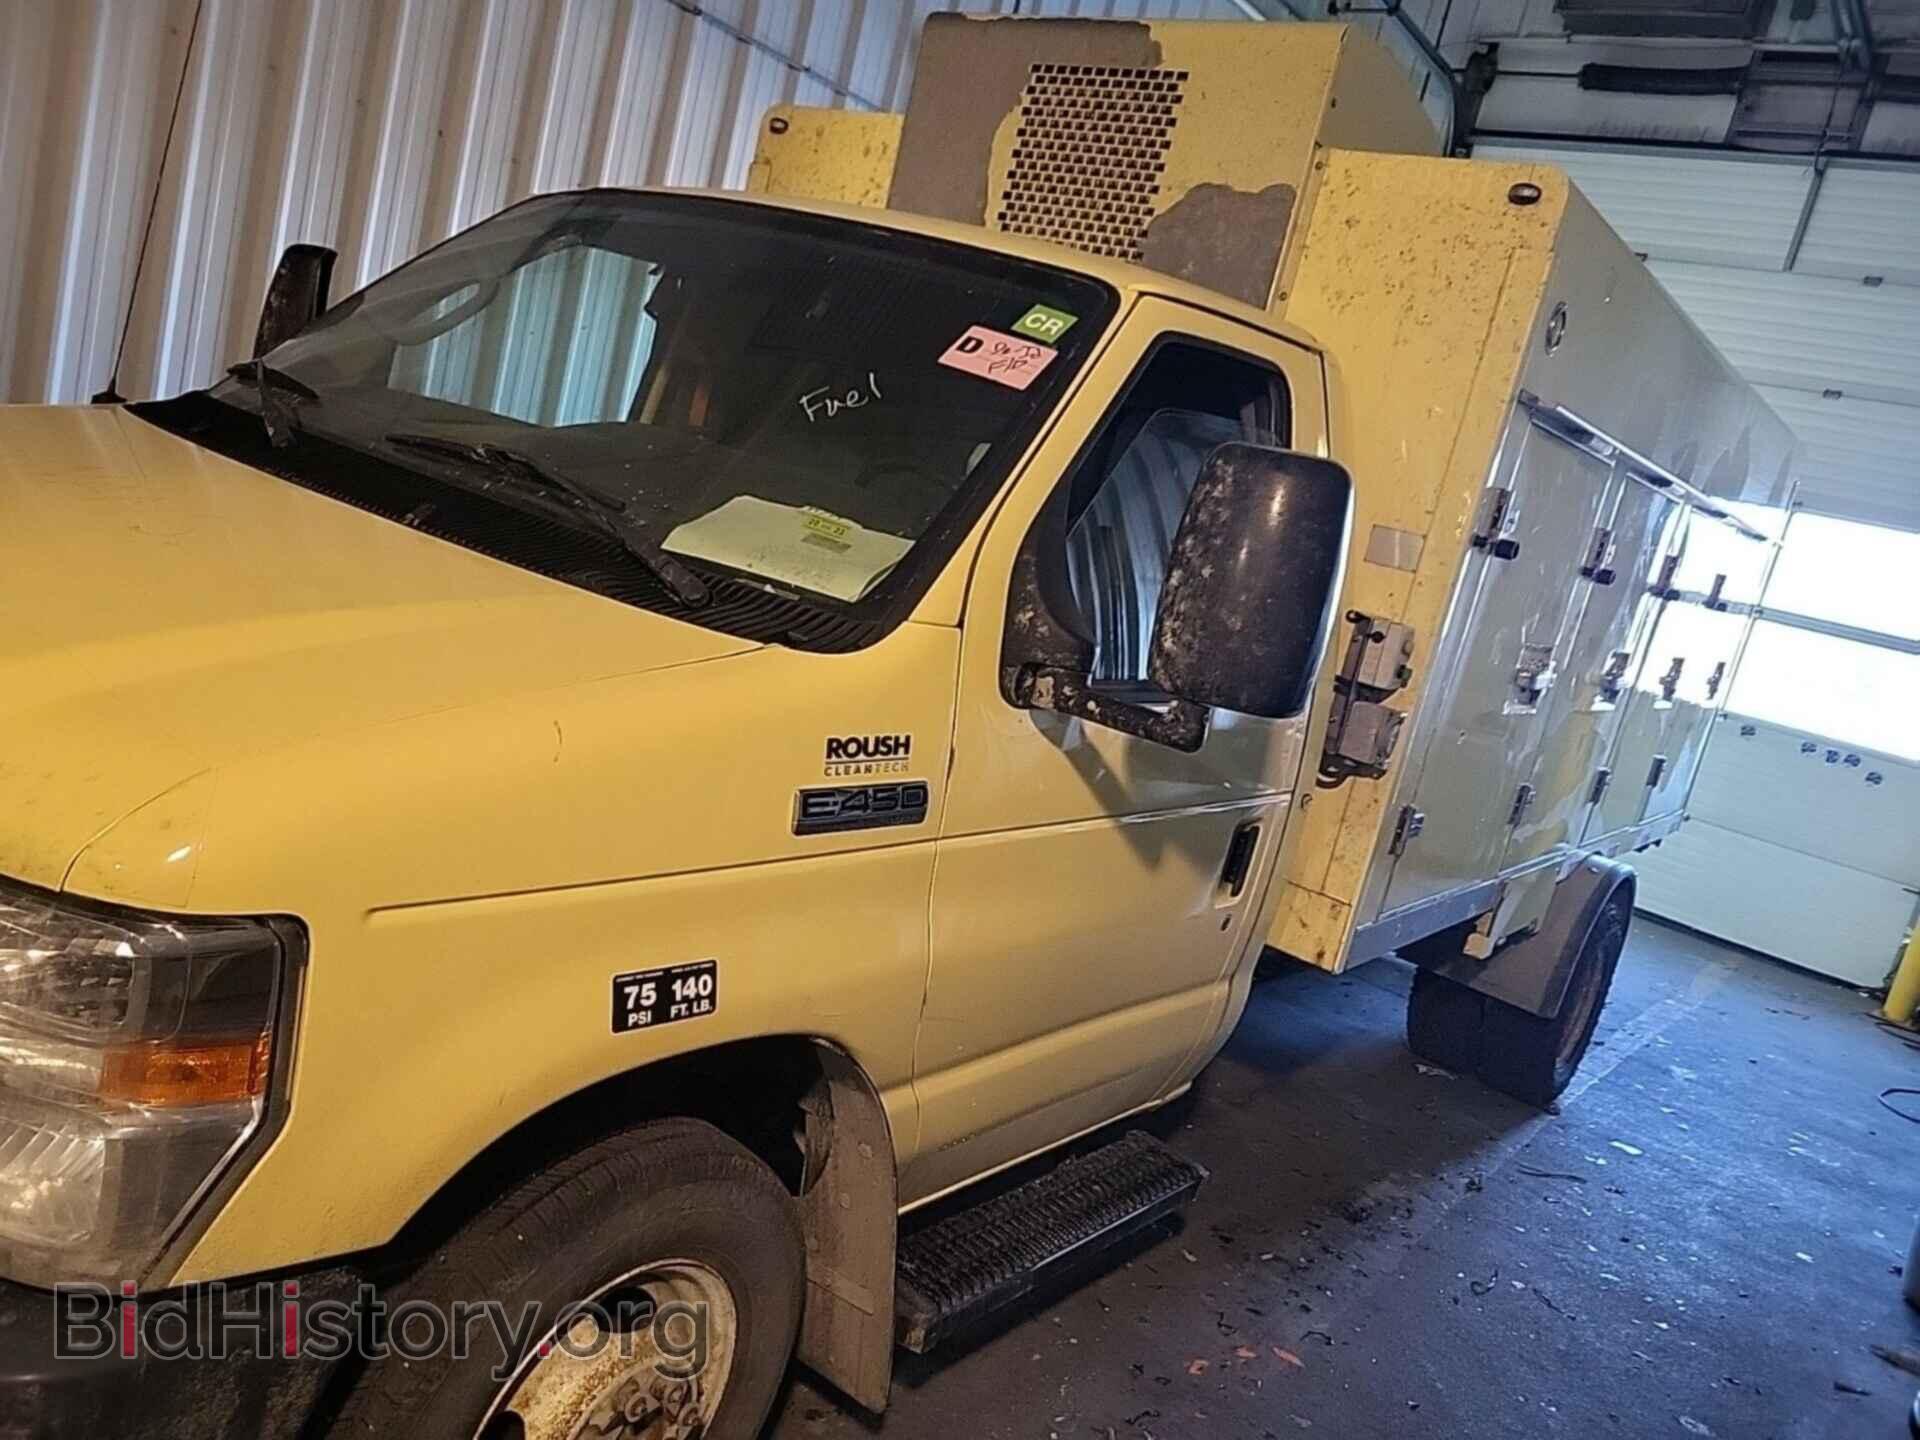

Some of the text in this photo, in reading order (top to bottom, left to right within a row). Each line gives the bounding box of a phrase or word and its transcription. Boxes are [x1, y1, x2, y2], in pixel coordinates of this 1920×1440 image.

[1024, 313, 1063, 335] CR
[956, 336, 984, 353] D
[798, 372, 882, 422] Fuel
[825, 735, 911, 759] ROUSH
[824, 762, 909, 776] CLEANTECH
[801, 784, 928, 818] E450
[624, 982, 657, 1010] 75
[671, 974, 713, 1001] 140
[627, 1010, 652, 1027] PSI
